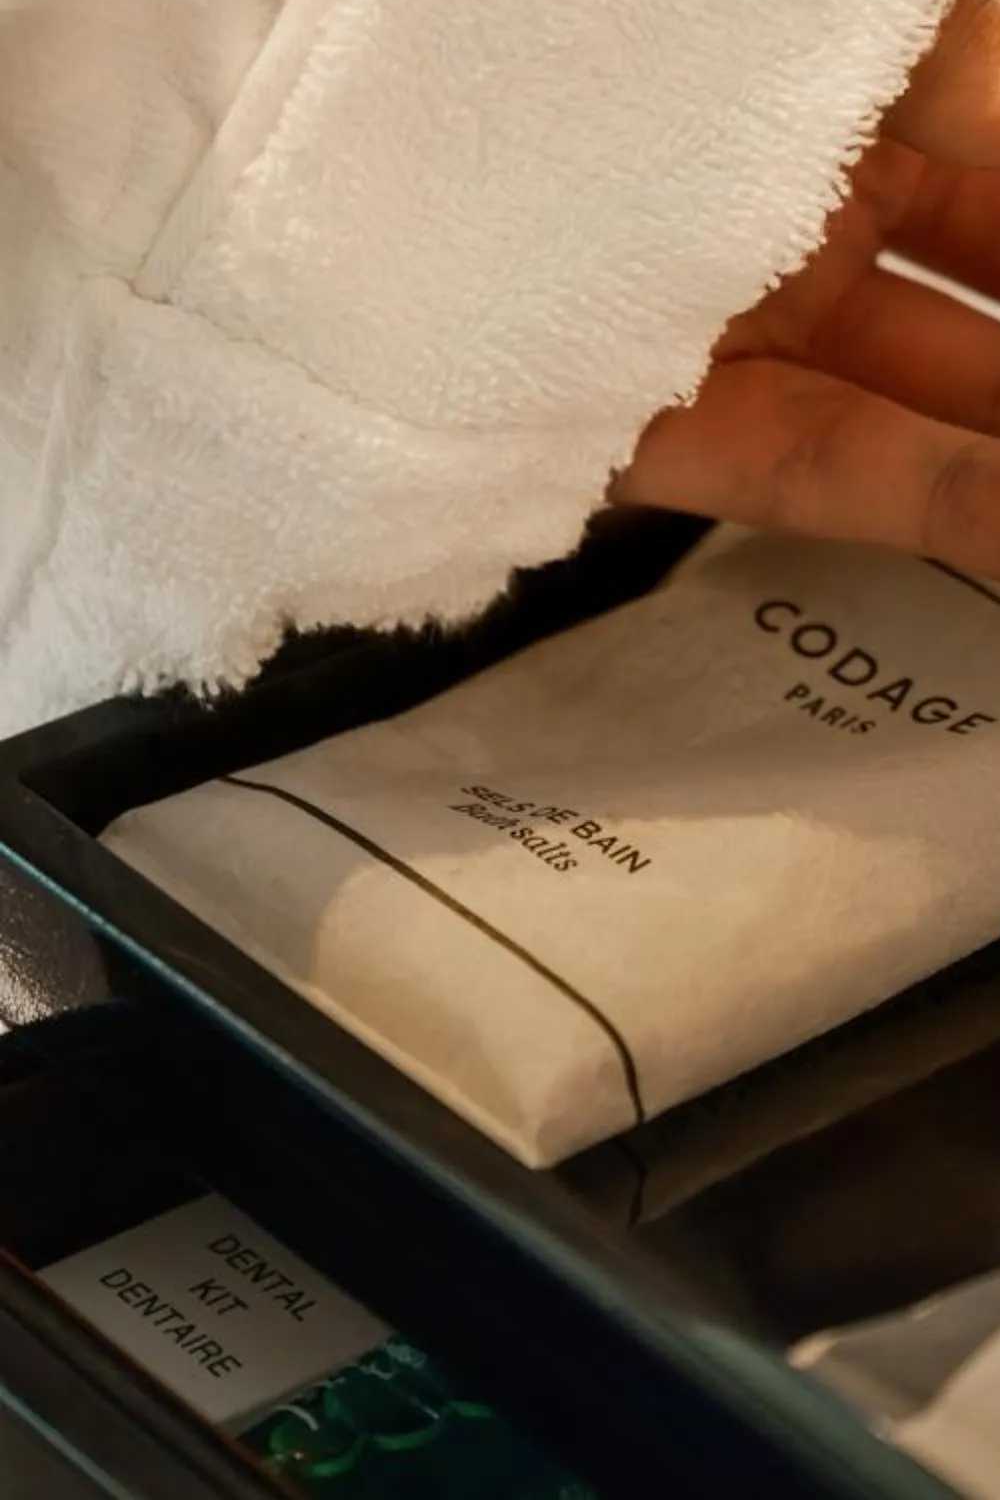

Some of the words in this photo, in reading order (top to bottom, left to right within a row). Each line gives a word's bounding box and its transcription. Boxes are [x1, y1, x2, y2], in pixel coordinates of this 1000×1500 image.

[754, 599, 997, 735] CODAGE
[784, 682, 877, 734] PARIS
[459, 784, 536, 814] SELS
[528, 805, 582, 825] DE
[569, 819, 653, 874] BAIN
[509, 826, 579, 873] salts
[188, 1278, 250, 1317] KIT
[208, 1233, 319, 1322] DENTAL
[99, 1267, 244, 1378] DENTAIRE
